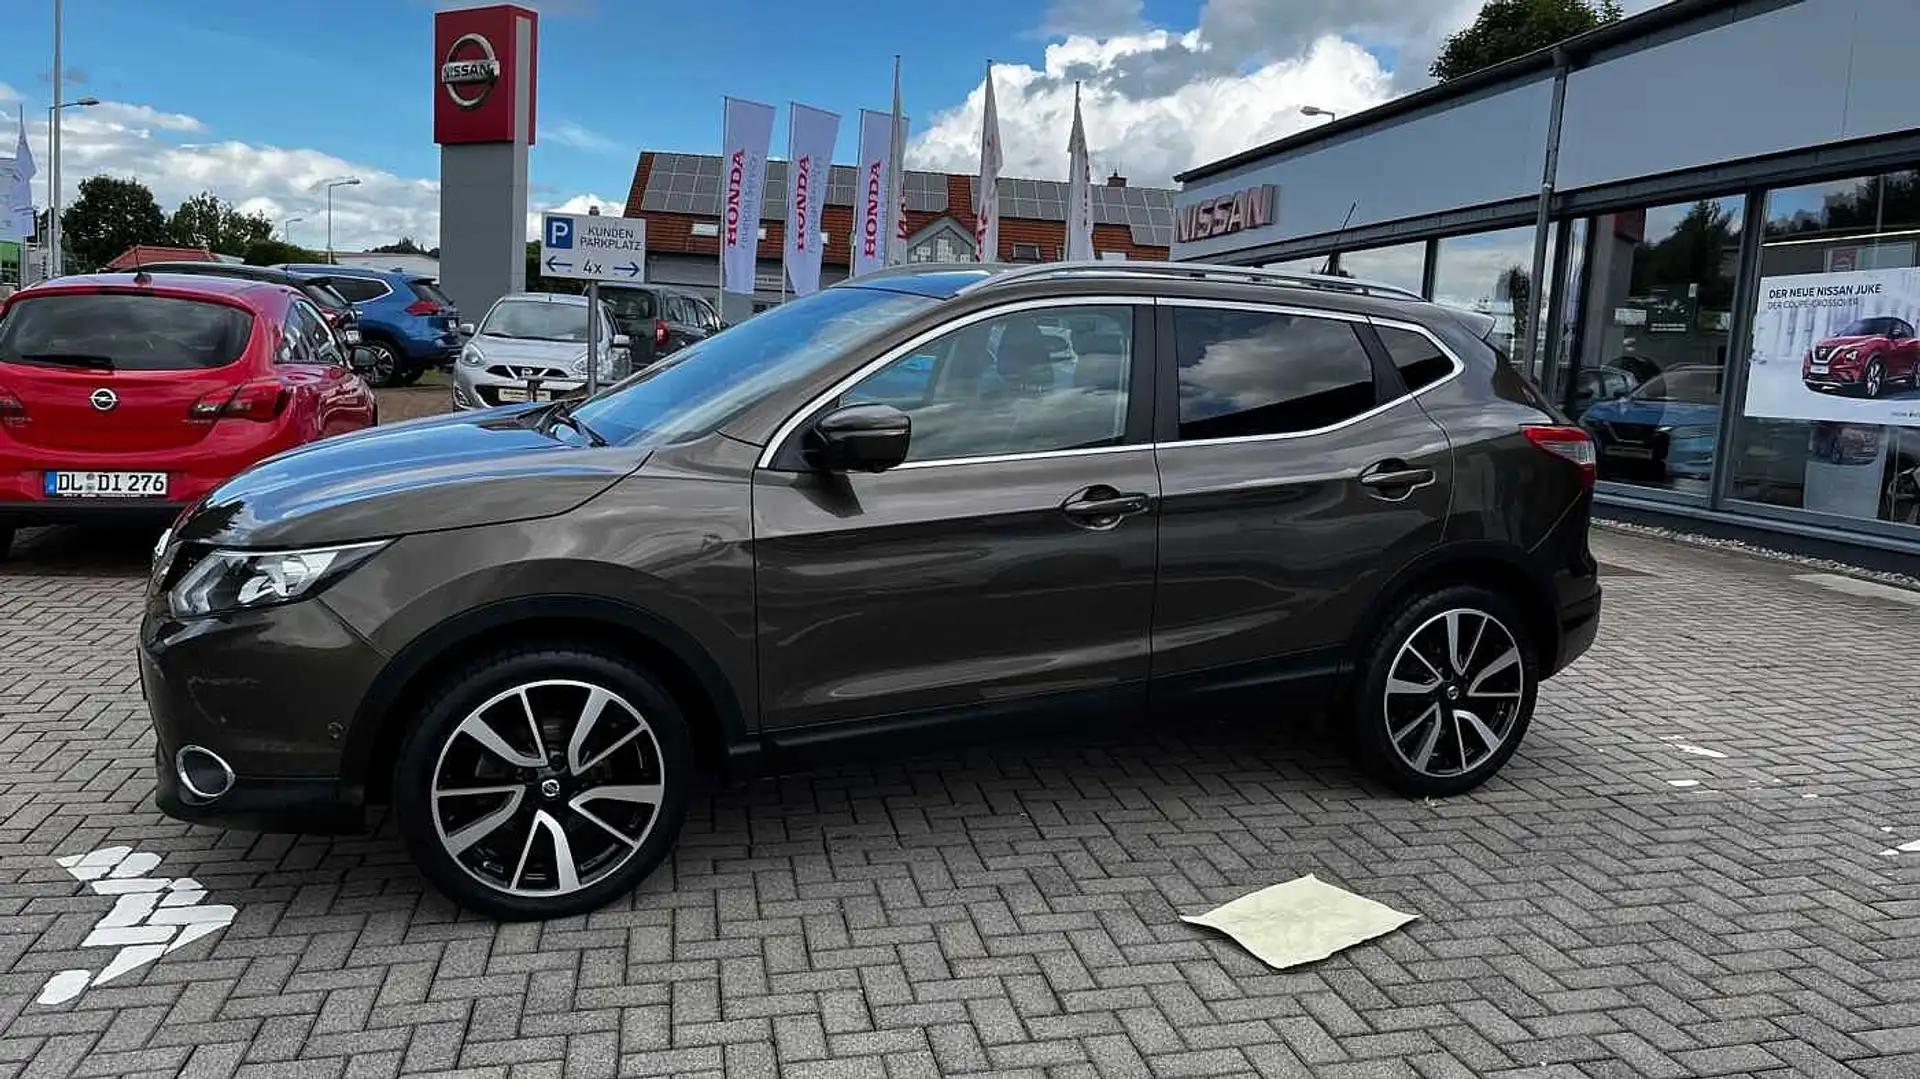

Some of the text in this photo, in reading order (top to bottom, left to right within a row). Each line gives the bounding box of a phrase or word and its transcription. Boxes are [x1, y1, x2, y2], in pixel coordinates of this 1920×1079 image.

[727, 148, 745, 246] HONDA
[796, 154, 810, 251] HONDA
[864, 160, 881, 257] HONDA
[1174, 184, 1275, 243] NISSAN
[551, 221, 569, 244] P
[580, 236, 643, 250] PARKPLATZ
[588, 225, 634, 238] KUNDEN
[1769, 283, 1882, 299] DER NEUE NISSAN JUKE
[58, 473, 164, 492] DL DI 276
